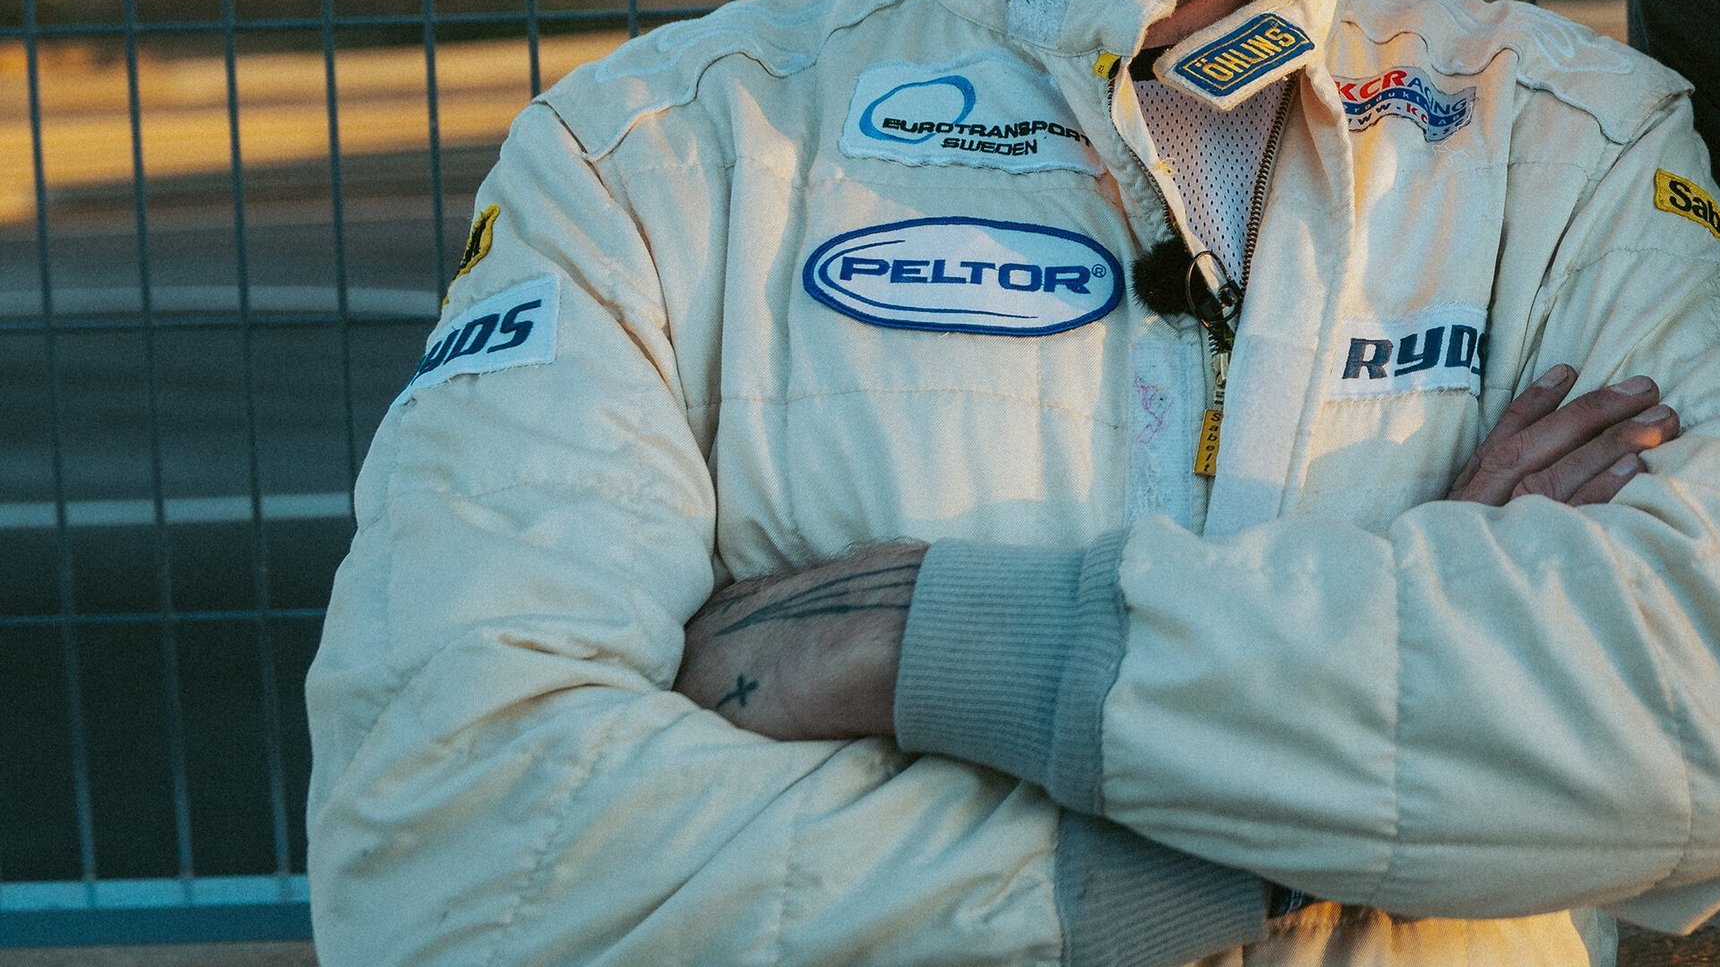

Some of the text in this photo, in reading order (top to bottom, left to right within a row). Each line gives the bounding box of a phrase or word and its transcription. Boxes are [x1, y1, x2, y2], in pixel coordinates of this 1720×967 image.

[1195, 25, 1297, 82] ÖHLINS
[882, 117, 1094, 147] EUROTRANSPORT
[940, 137, 1038, 157] SWEDEN
[411, 298, 542, 382] YDS
